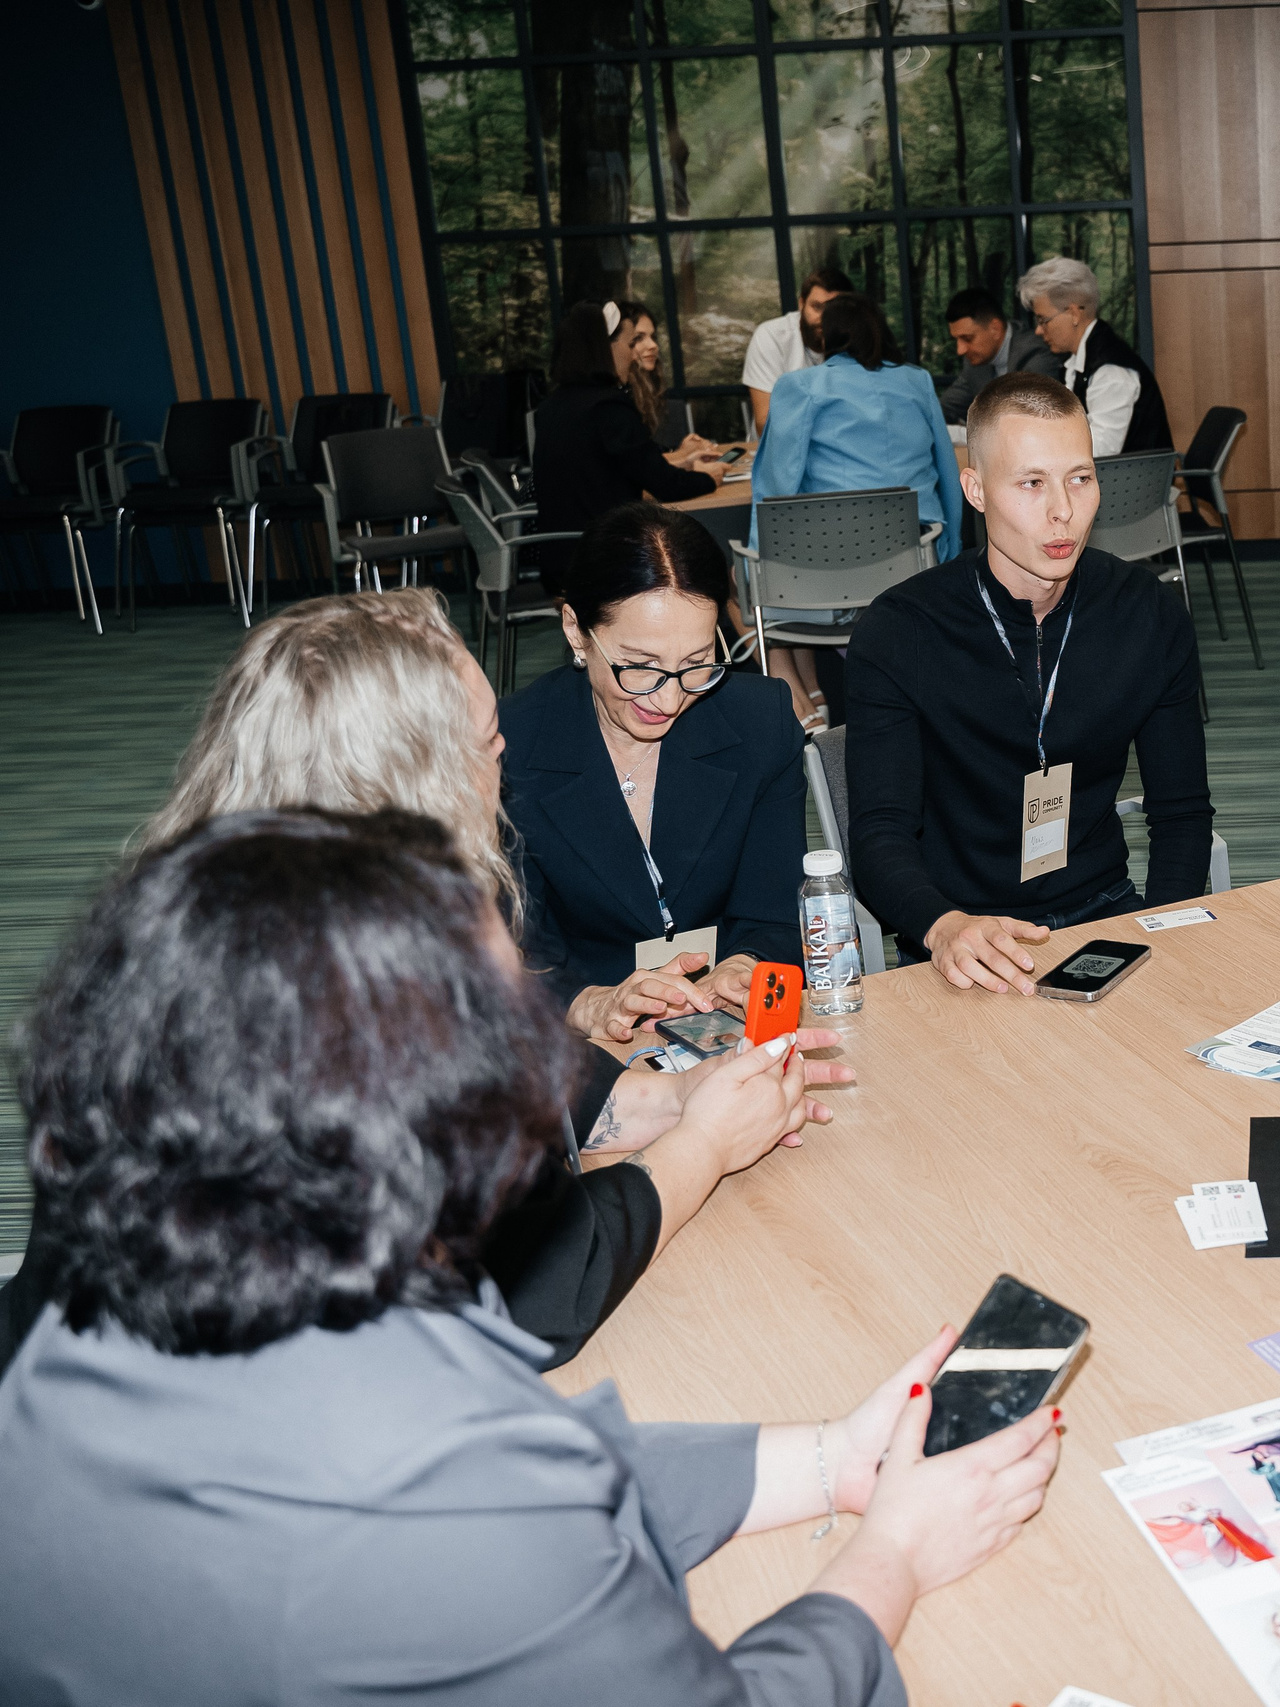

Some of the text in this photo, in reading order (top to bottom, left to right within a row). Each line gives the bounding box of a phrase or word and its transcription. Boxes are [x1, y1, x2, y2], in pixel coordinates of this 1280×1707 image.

[1042, 795, 1064, 809] PRIDE
[1042, 804, 1064, 815] COMMUNITY
[808, 918, 834, 991] BAIKAL
